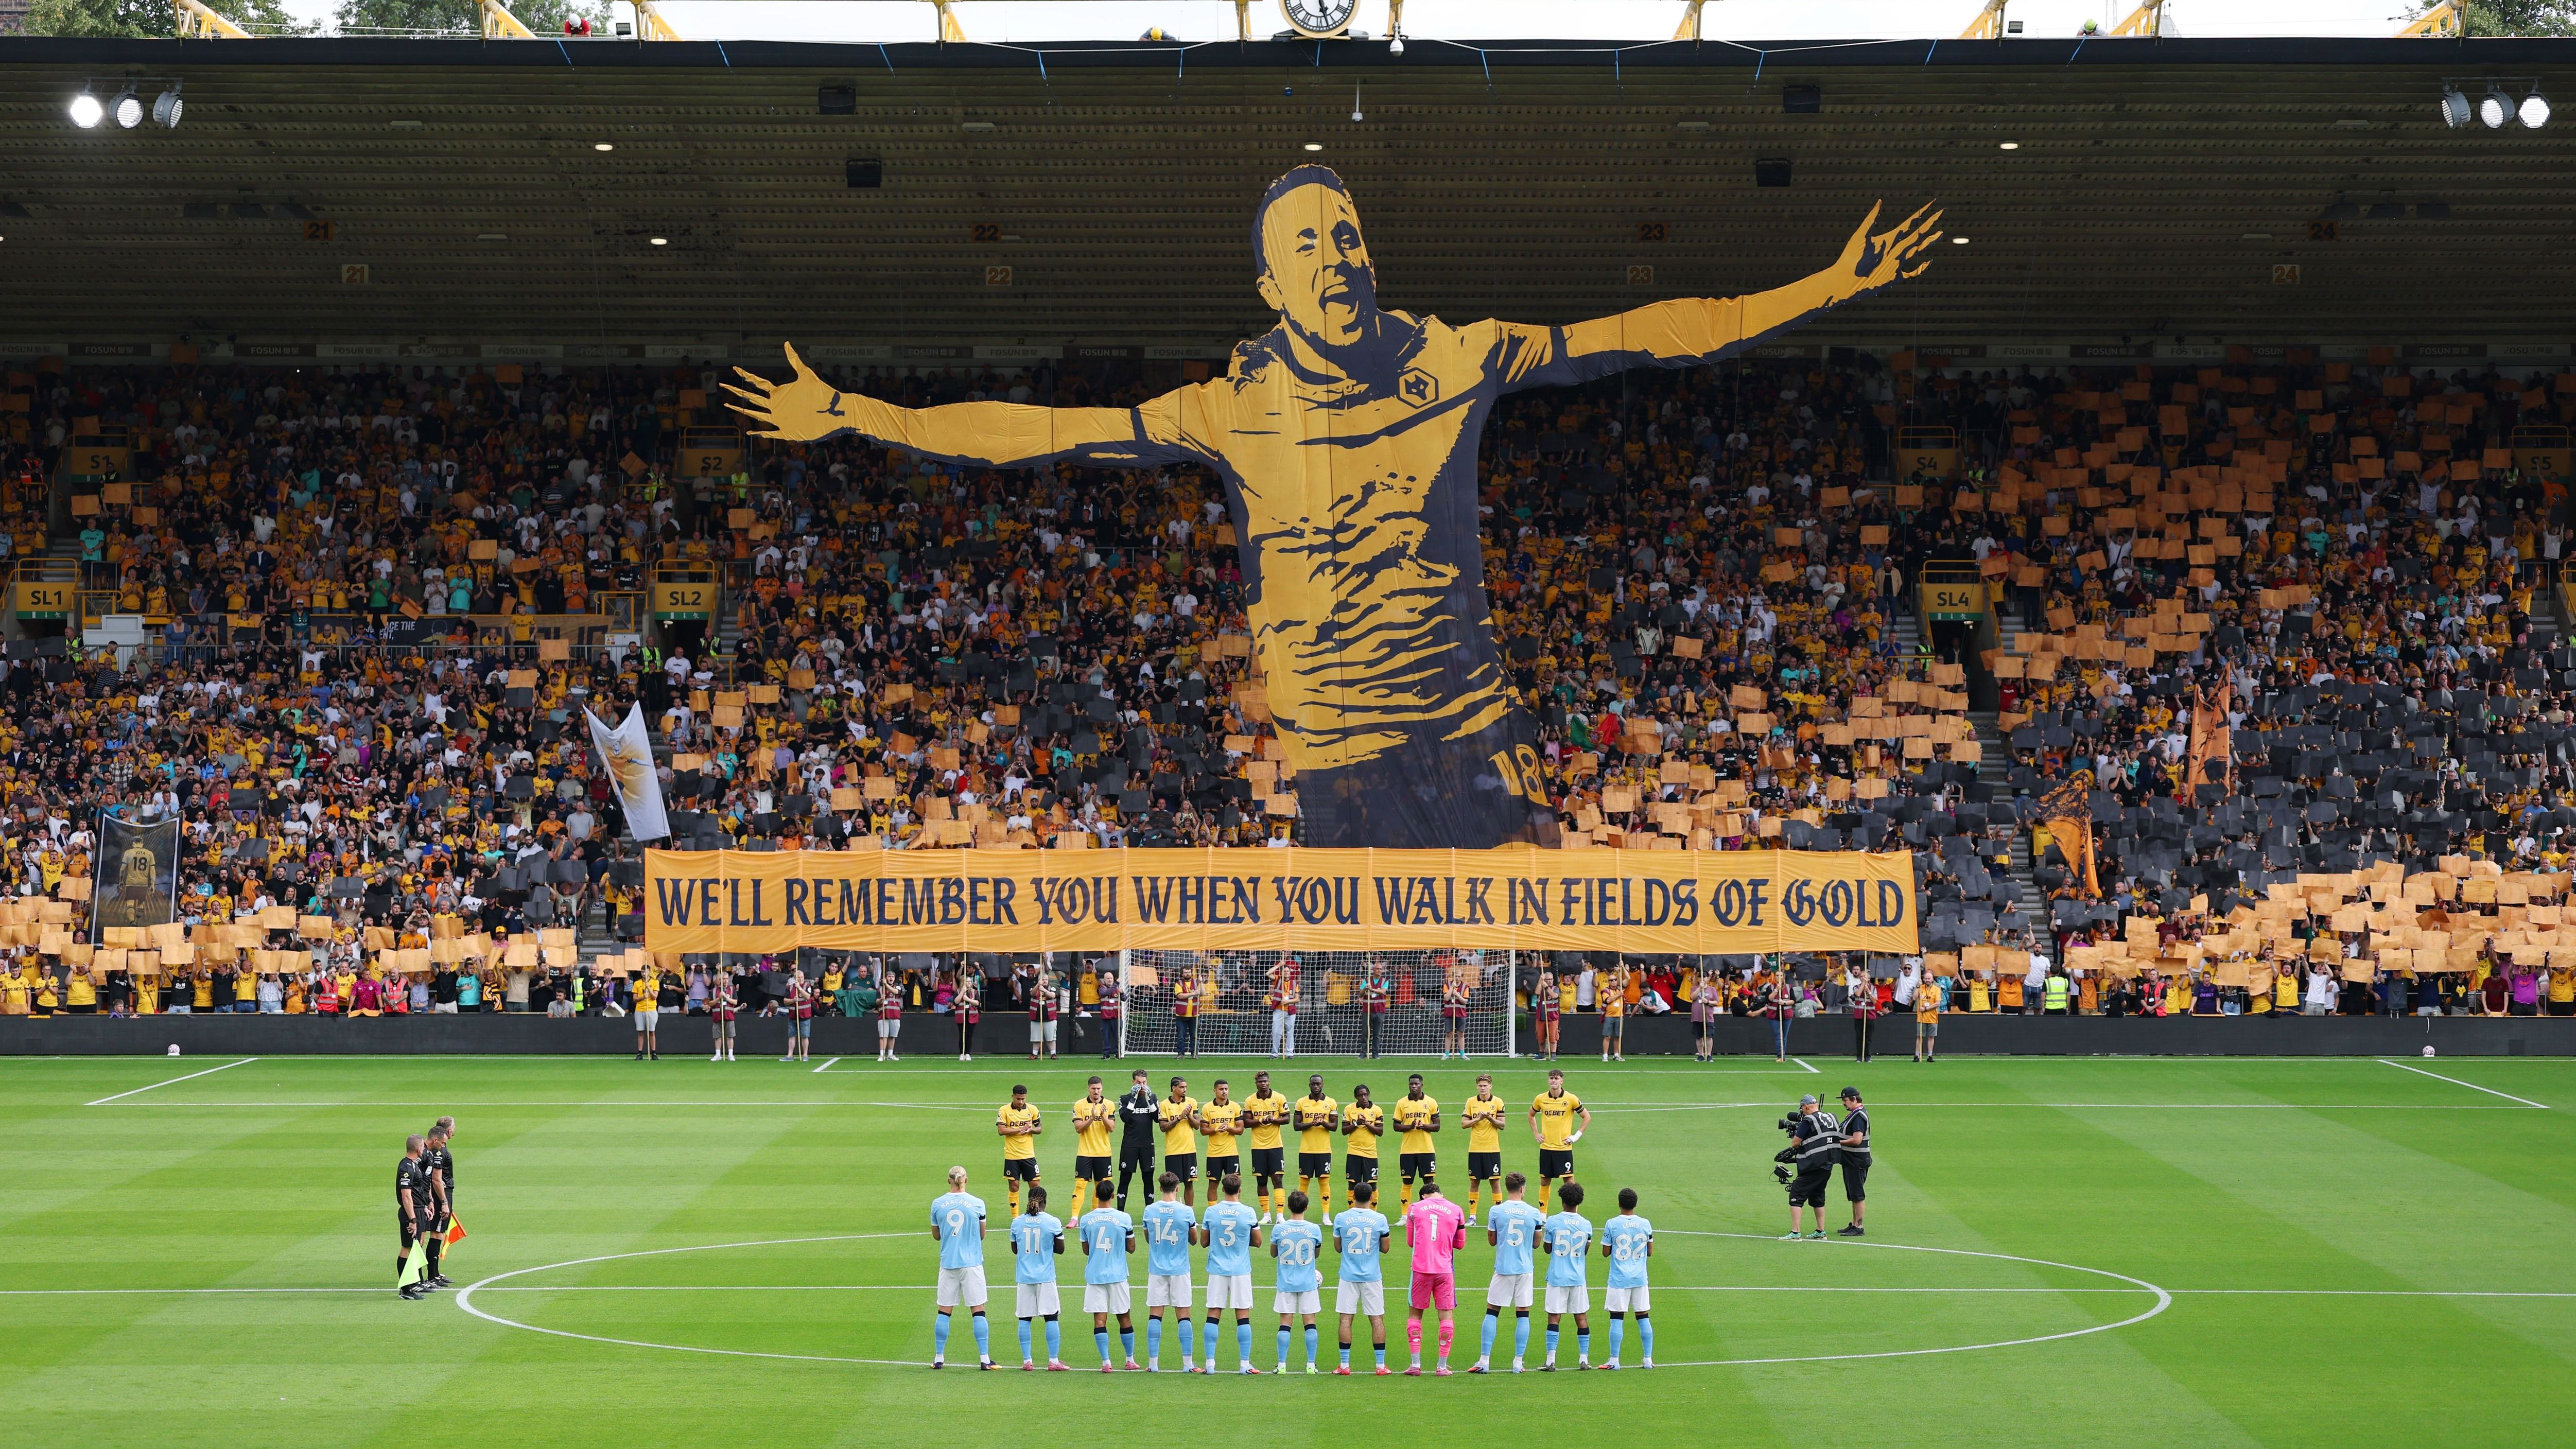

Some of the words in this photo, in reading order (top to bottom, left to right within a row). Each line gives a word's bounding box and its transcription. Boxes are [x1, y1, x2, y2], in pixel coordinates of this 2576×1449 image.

[309, 222, 328, 239] 21
[974, 224, 999, 241] 22
[1641, 224, 1664, 240] 23
[2310, 222, 2336, 239] 24
[346, 266, 365, 283] 21
[988, 268, 1010, 285] 22
[1629, 266, 1651, 284] 23
[2274, 266, 2298, 283] 24
[91, 455, 110, 469] S1
[702, 457, 722, 470] S2
[1917, 457, 1937, 470] S4
[2531, 457, 2551, 470] S5
[30, 590, 62, 605] SL1
[669, 591, 701, 605] SL2
[1937, 592, 1969, 606] SL4
[401, 621, 416, 631] THE
[1488, 744, 1553, 807] 18
[133, 857, 147, 871] 18
[654, 878, 773, 926] WE'LL
[784, 877, 1017, 926] REMEMBER
[1030, 876, 1120, 925] YOU
[1130, 876, 1262, 924] WHEN
[1271, 876, 1361, 925] YOU
[1372, 877, 1495, 925] WALK
[1506, 877, 1550, 926] IN
[1559, 878, 1699, 926] FIELDS
[1709, 878, 1769, 927] OF
[1780, 878, 1904, 927] GOLD
[1152, 1157, 1154, 1165] 1
[1234, 1163, 1239, 1173] 7
[1431, 1161, 1436, 1171] 5
[1493, 1163, 1499, 1173] 6
[1565, 1162, 1571, 1171] 9
[1034, 1164, 1040, 1174] 8
[1108, 1165, 1112, 1174] 2
[1371, 1168, 1379, 1177] 27
[940, 1196, 972, 1209] HAALAND
[1420, 1204, 1452, 1215] TRAFFORD
[1504, 1208, 1528, 1216] STONES
[946, 1209, 965, 1236] 9
[1429, 1214, 1439, 1242] 1
[1152, 1218, 1179, 1245] 14
[1219, 1219, 1237, 1247] 3
[1280, 1227, 1313, 1238] BERNARDO
[1506, 1219, 1525, 1247] 5
[1023, 1227, 1041, 1254] 11
[1095, 1226, 1112, 1253] 4
[1347, 1227, 1372, 1254] 21
[1554, 1230, 1587, 1258] 52
[1615, 1233, 1648, 1261] 82
[1279, 1238, 1314, 1266] 20
